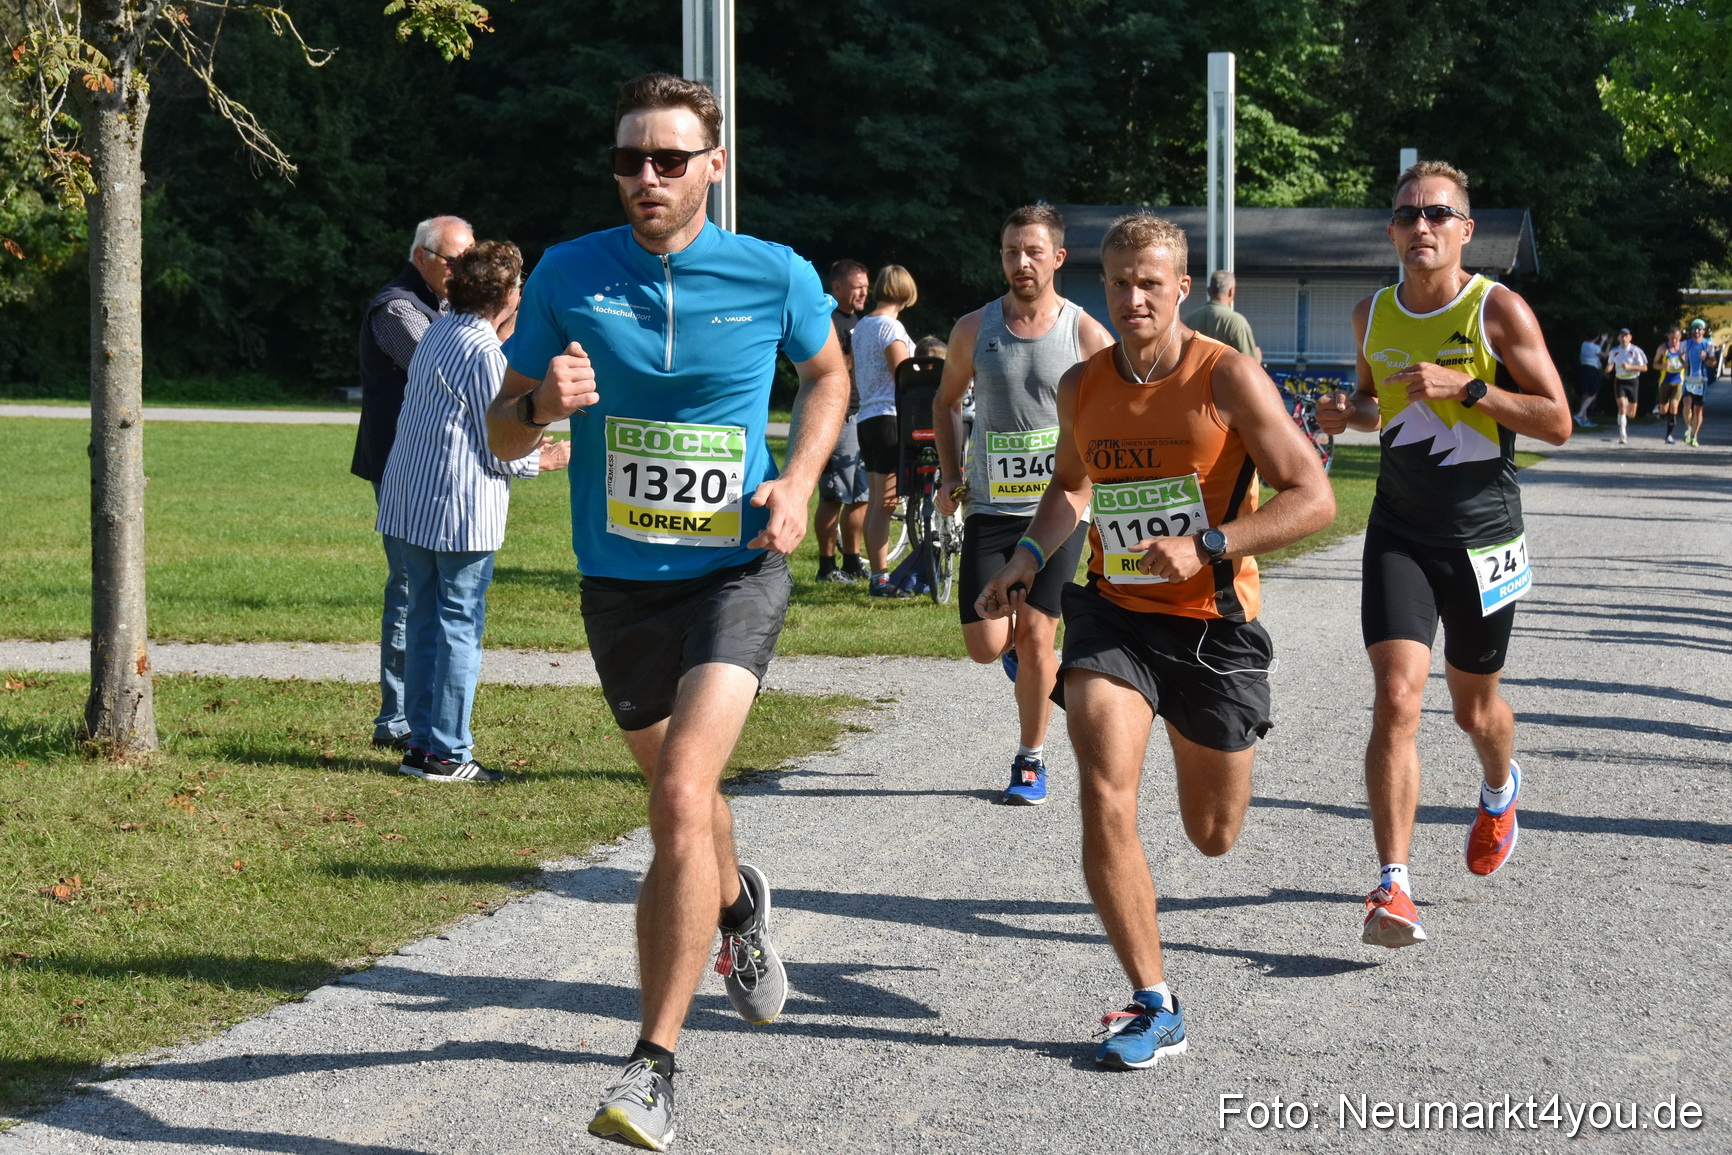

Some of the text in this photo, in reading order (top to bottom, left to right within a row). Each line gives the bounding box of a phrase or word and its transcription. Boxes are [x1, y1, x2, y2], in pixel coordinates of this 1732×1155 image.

[1435, 356, 1475, 367] Runners
[615, 423, 733, 458] BOCK
[992, 430, 1059, 451] BOCK
[1088, 439, 1120, 450] OPTIK
[1093, 448, 1162, 470] OEXL
[622, 462, 727, 504] 1320
[1096, 480, 1192, 511] BOCK
[629, 510, 711, 532] LORENZ
[1108, 512, 1191, 548] 1192
[1484, 541, 1525, 583] 241
